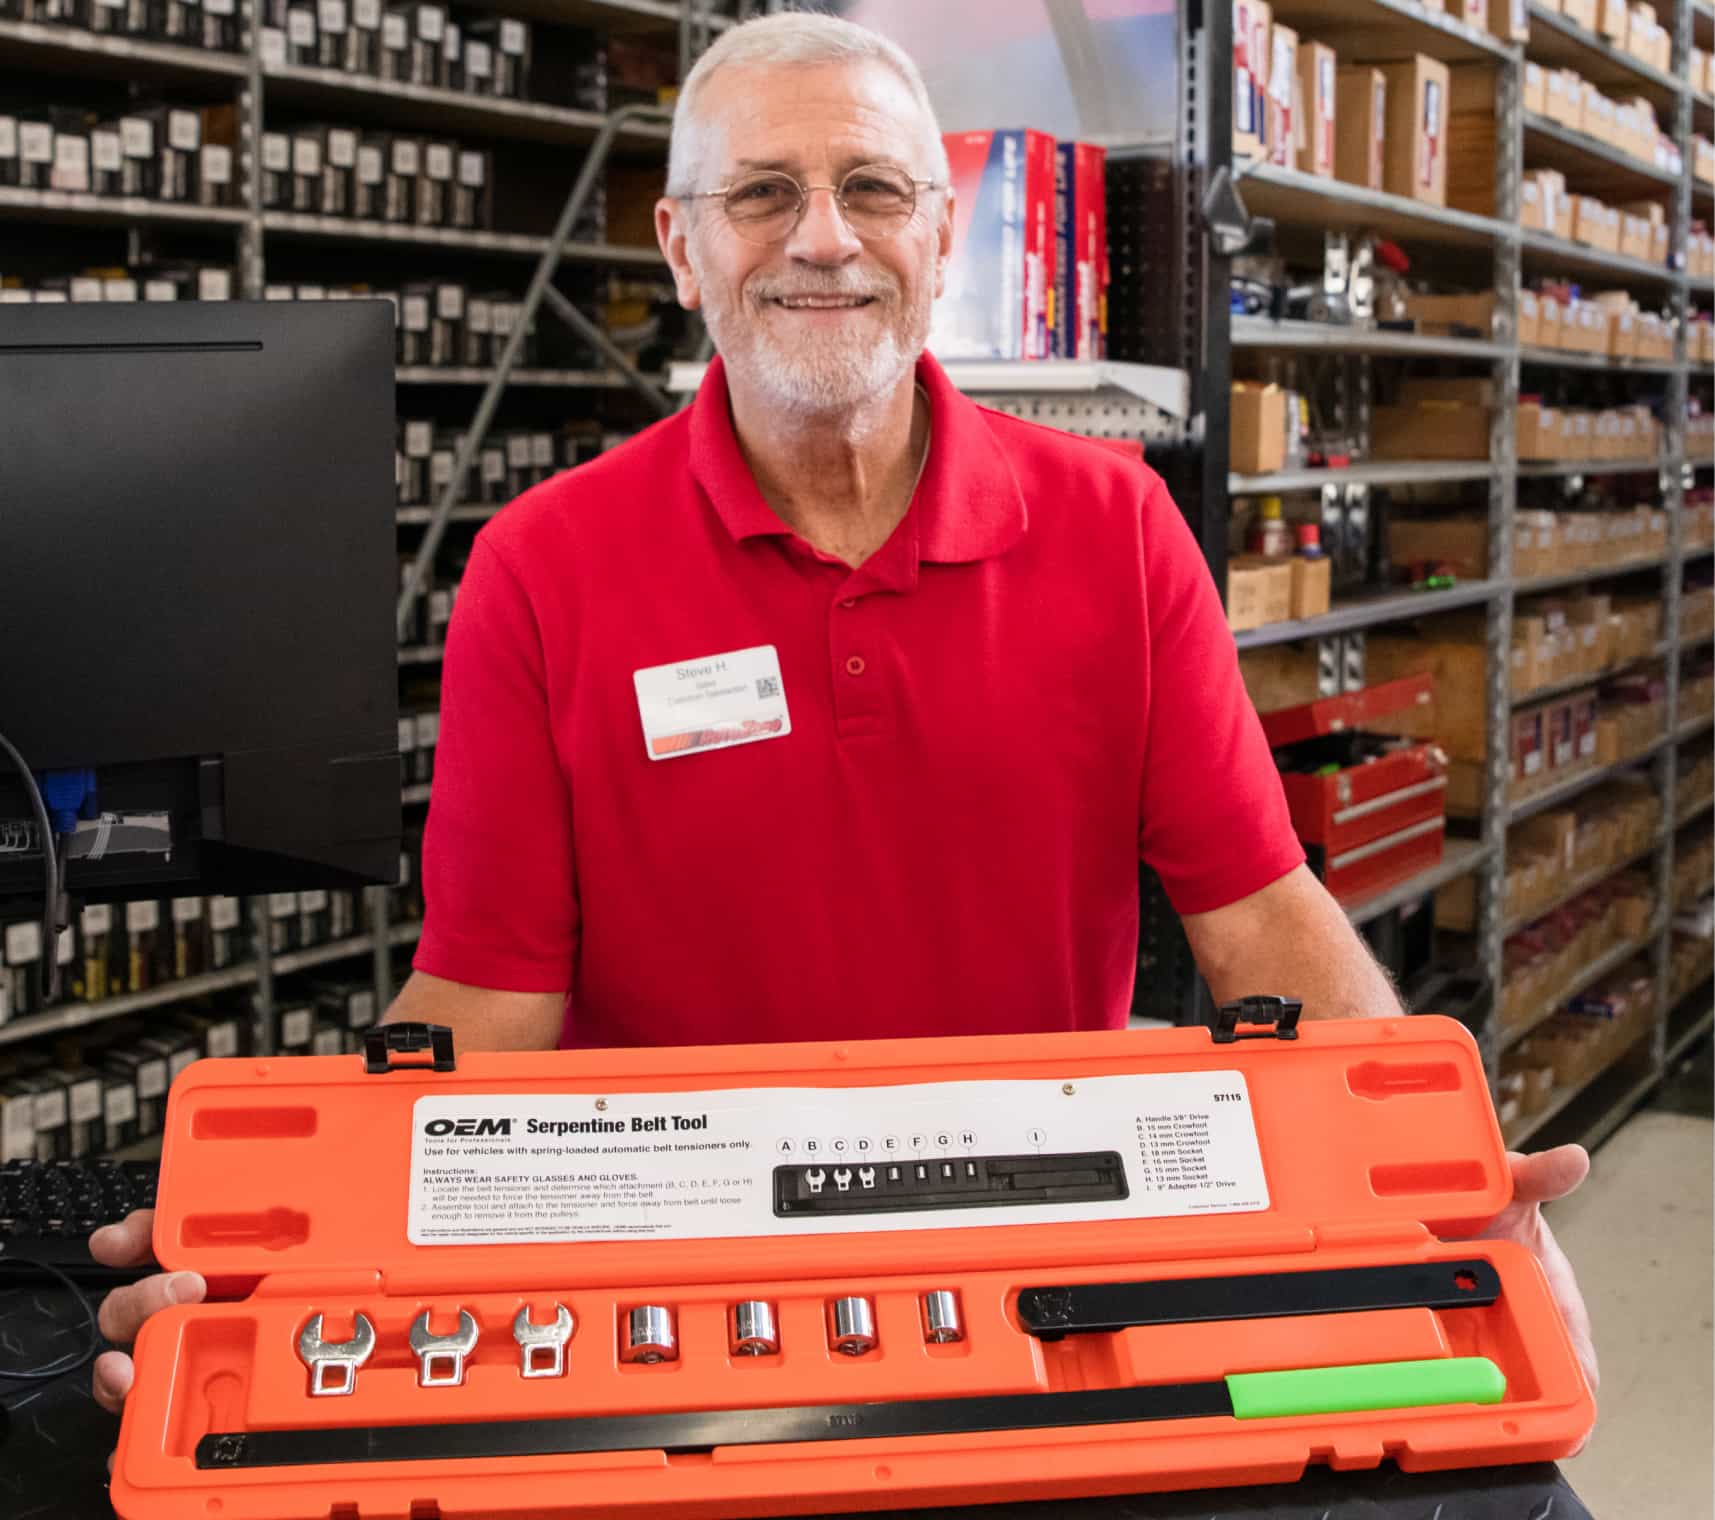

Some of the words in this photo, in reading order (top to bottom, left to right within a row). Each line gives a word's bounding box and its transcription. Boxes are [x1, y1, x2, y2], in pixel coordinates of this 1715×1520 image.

[676, 665, 713, 681] Steve
[1213, 1093, 1242, 1102] 57115
[1189, 1113, 1209, 1121] Drive
[526, 1117, 626, 1137] Serpentine
[631, 1115, 667, 1132] Belt
[671, 1113, 708, 1131] Tool
[1173, 1122, 1208, 1130] Crowfoot
[781, 1141, 791, 1151] A
[808, 1141, 817, 1151] B
[834, 1141, 845, 1151] C
[859, 1140, 869, 1150] D
[886, 1139, 895, 1148] E
[913, 1137, 921, 1147] F
[937, 1135, 948, 1145] G
[963, 1134, 973, 1144] H
[1176, 1139, 1211, 1147] Crowfoot
[424, 1147, 444, 1156] Use
[446, 1147, 460, 1156] for
[463, 1146, 504, 1156] vehicles
[507, 1145, 528, 1155] with
[530, 1145, 600, 1156] spring-loaded
[601, 1143, 651, 1154] automatic
[653, 1143, 672, 1153] belt
[674, 1141, 726, 1153] tensioners
[1179, 1156, 1205, 1164] Socket
[423, 1167, 477, 1176] Instructions:
[1181, 1164, 1207, 1172] Socket
[423, 1176, 462, 1184] ALWAYS
[464, 1175, 492, 1183] WEAR
[494, 1175, 530, 1183] SAFETY
[532, 1174, 575, 1182] GLASSES
[577, 1174, 597, 1182] AND
[432, 1184, 460, 1193] Locate
[462, 1184, 475, 1192] the
[477, 1184, 492, 1192] belt
[494, 1184, 532, 1192] tensioner
[533, 1183, 549, 1191] and
[551, 1183, 591, 1191] determine
[593, 1182, 617, 1191] which
[620, 1181, 663, 1190] attachment
[1168, 1182, 1197, 1191] Adapter
[1216, 1180, 1236, 1188] Drive
[432, 1193, 446, 1201] will
[447, 1193, 458, 1201] be
[460, 1193, 491, 1201] needed
[502, 1192, 523, 1200] force
[525, 1192, 538, 1200] the
[603, 1191, 622, 1200] from
[623, 1191, 637, 1199] the
[432, 1202, 472, 1211] Assemble
[474, 1202, 489, 1210] tool
[490, 1202, 507, 1210] and
[508, 1201, 534, 1210] attach
[535, 1201, 544, 1209] to
[600, 1200, 616, 1208] and
[617, 1200, 638, 1208] force
[640, 1200, 661, 1209] away
[663, 1199, 682, 1207] from
[683, 1198, 699, 1207] belt
[700, 1197, 718, 1206] until
[719, 1197, 742, 1205] loose
[431, 1211, 463, 1221] enough
[464, 1211, 472, 1219] to
[474, 1212, 505, 1220] remove
[514, 1210, 533, 1219] from
[534, 1210, 548, 1218] the
